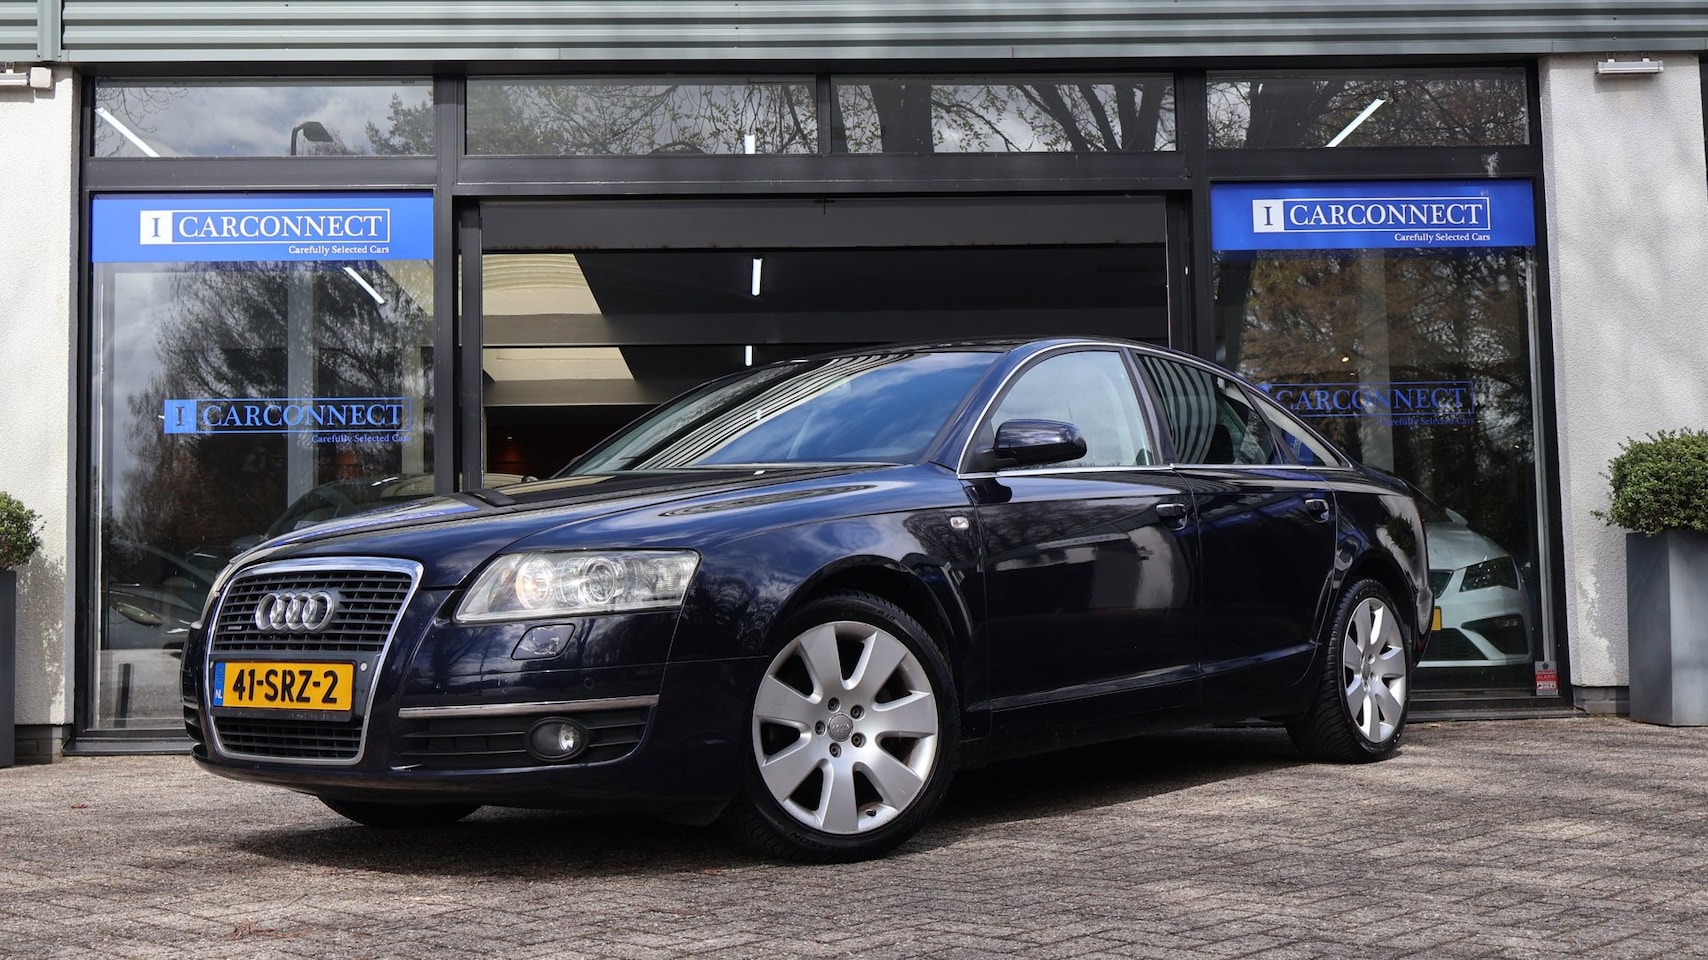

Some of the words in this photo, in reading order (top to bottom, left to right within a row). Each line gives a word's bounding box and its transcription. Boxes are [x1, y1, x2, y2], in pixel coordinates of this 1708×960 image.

[1289, 203, 1483, 226] CARCONNECT
[178, 215, 383, 238] CARCONNECT
[1394, 233, 1434, 244] Carefully
[1435, 232, 1470, 241] Selected
[1471, 232, 1491, 241] Cars
[288, 245, 330, 257] Carefully
[331, 245, 368, 254] Selected
[369, 245, 390, 254] Cars
[203, 404, 404, 427] CARCONNECT
[311, 434, 353, 445] Carefully
[354, 434, 390, 443] Selected
[215, 689, 223, 699] NL
[232, 669, 339, 704] 41-SRZ-2
